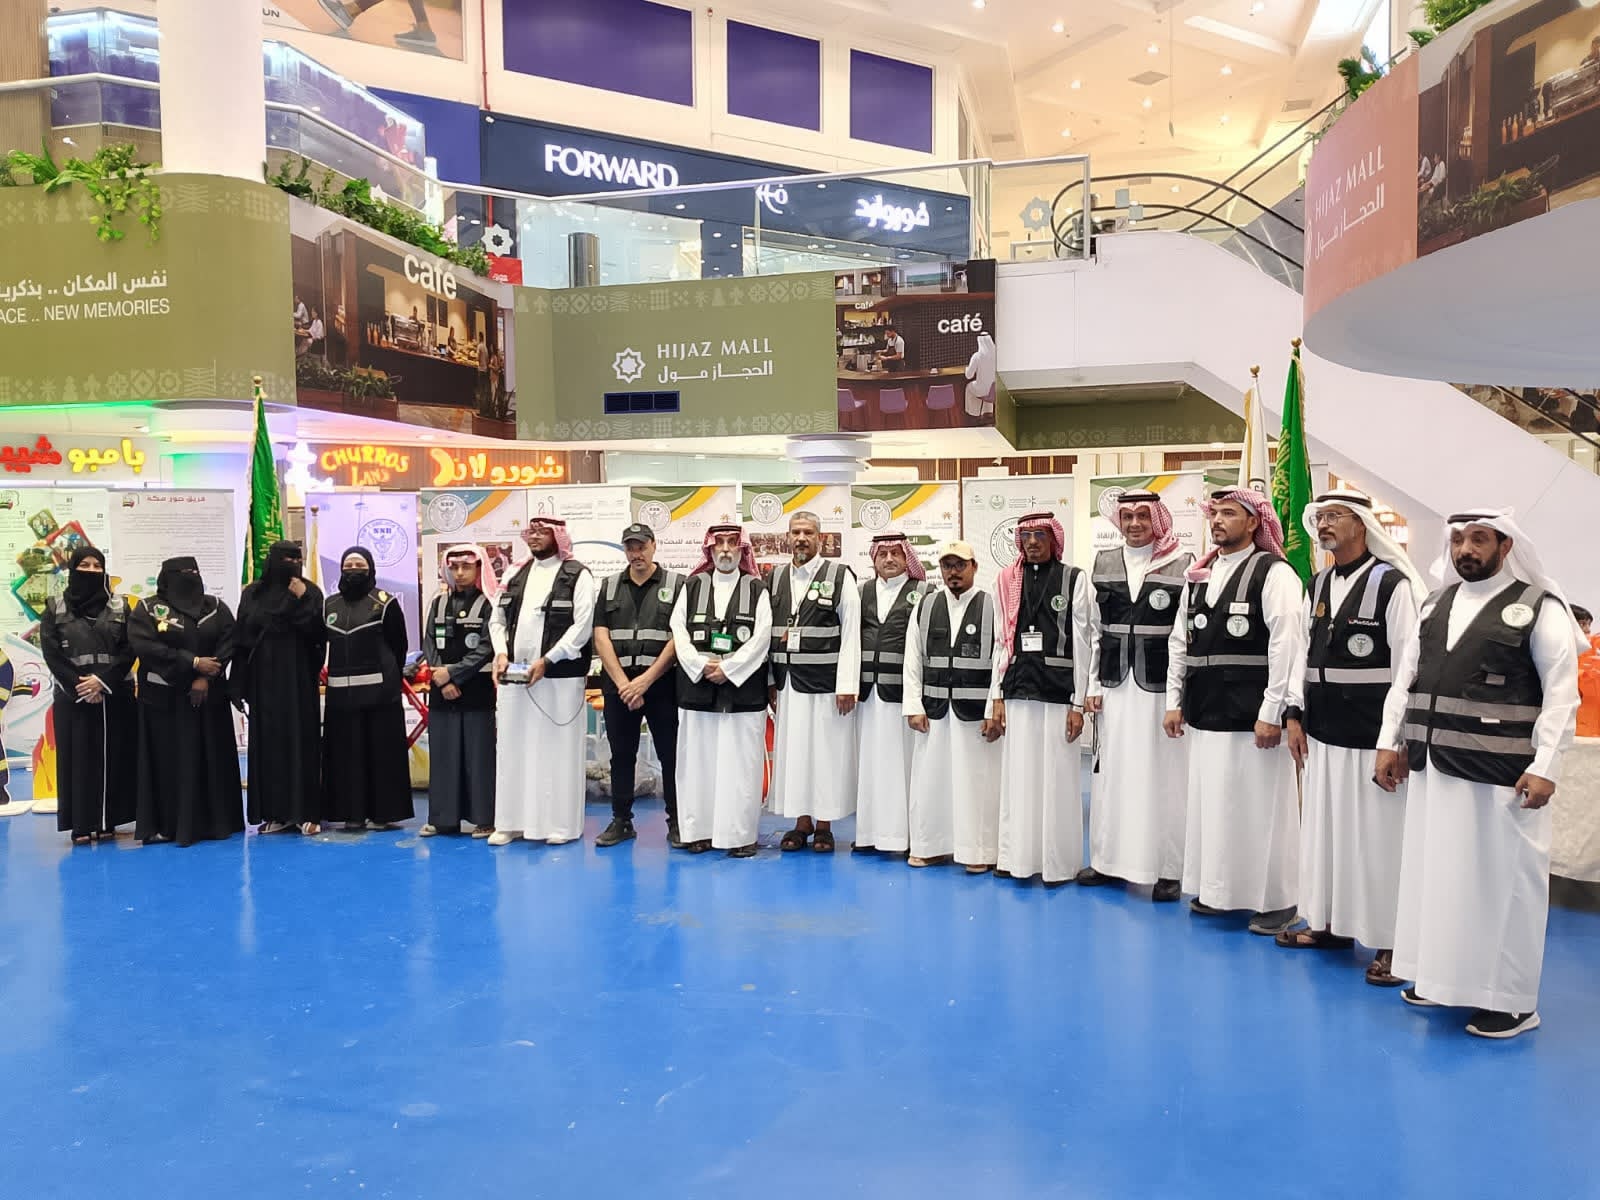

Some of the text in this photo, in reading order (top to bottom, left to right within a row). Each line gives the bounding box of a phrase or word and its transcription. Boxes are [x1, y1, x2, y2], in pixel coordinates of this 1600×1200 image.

[544, 143, 679, 189] FORWARD
[1314, 143, 1384, 222] HIJAZ MALL
[63, 272, 118, 297] المكان
[122, 269, 168, 294] نفس
[403, 252, 457, 300] café
[44, 302, 80, 321] NEW
[83, 298, 170, 318] MEMORIES
[937, 312, 983, 334] café
[656, 337, 773, 361] HIJAZ MALL
[657, 359, 773, 384] الحجاز مول
[67, 438, 145, 474] بامبو
[321, 445, 410, 473] CHURROS
